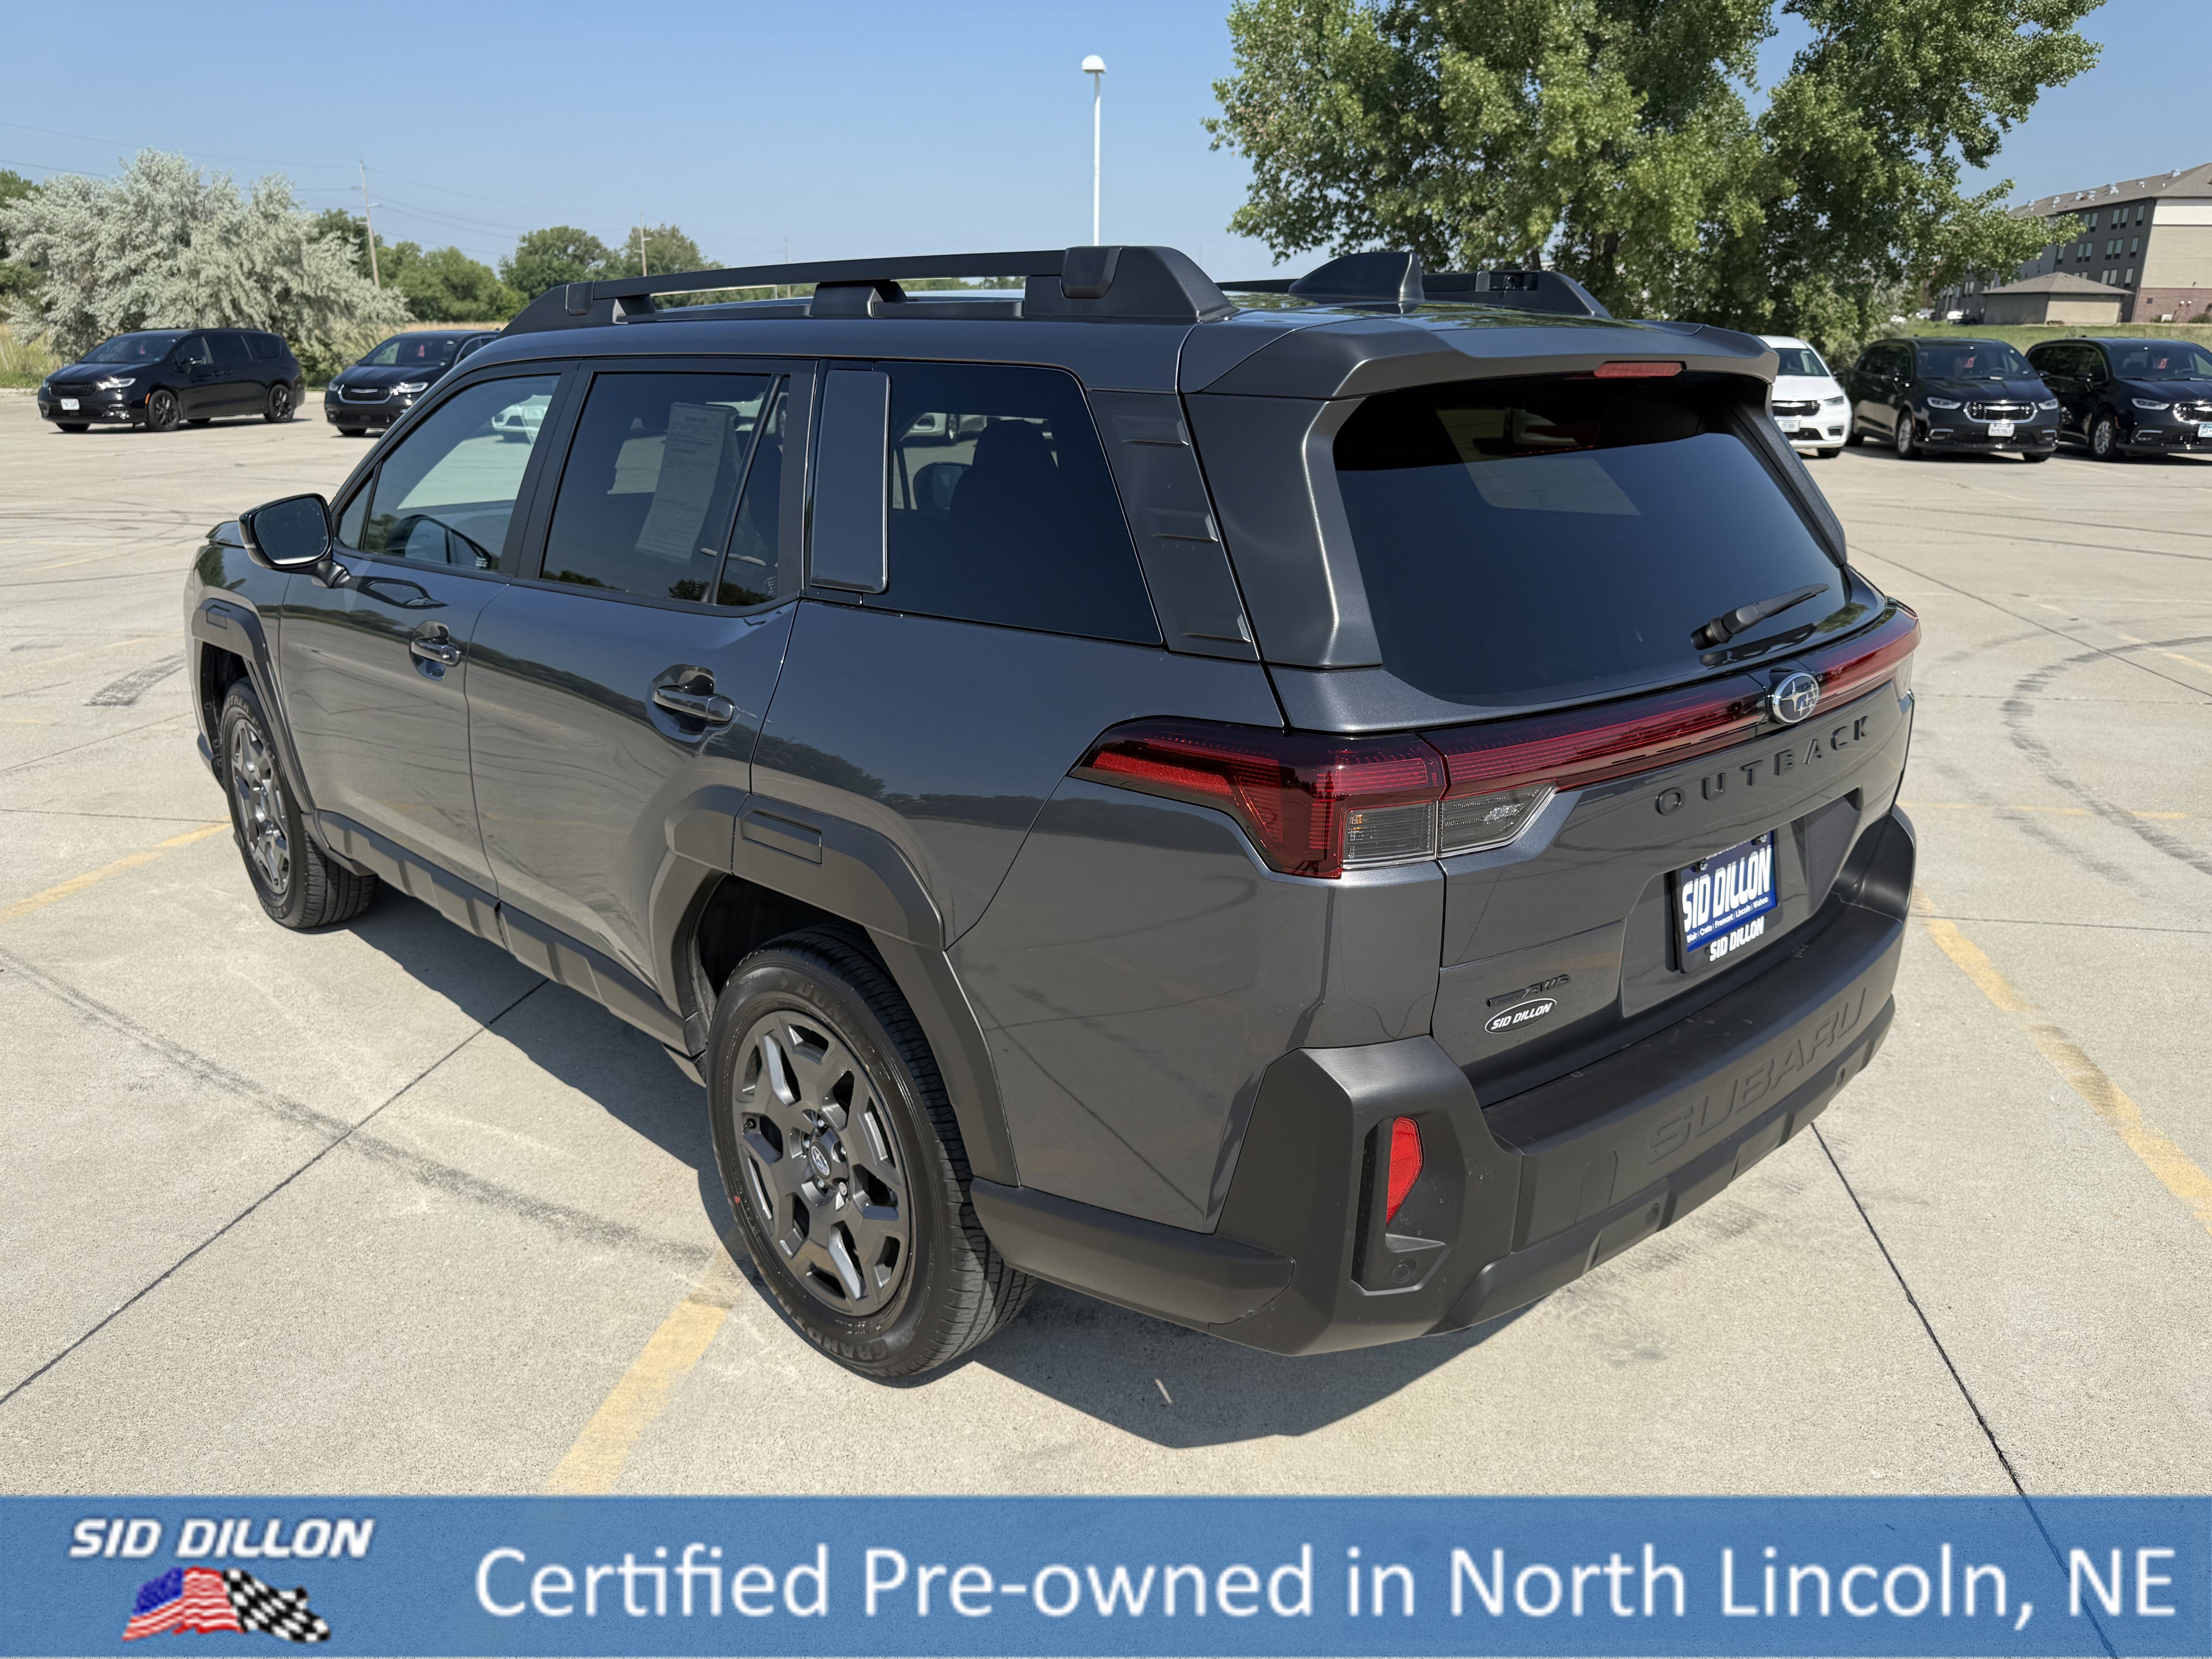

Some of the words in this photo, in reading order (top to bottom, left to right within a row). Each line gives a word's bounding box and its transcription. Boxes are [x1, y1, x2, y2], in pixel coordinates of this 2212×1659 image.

[1655, 715, 1869, 816] OUTBACK
[1682, 874, 1711, 932] SID
[1712, 845, 1772, 918] DILLON
[1686, 932, 1697, 943] Blair
[1699, 925, 1713, 936] Crete
[1714, 913, 1734, 929] Fremont
[1735, 905, 1751, 918] Lincoln
[1753, 896, 1769, 908] Wahoo
[1709, 936, 1728, 962] SID
[1729, 916, 1765, 951] DILLON
[1491, 1016, 1512, 1030] SID
[1512, 1002, 1553, 1024] DILLON
[1647, 987, 1867, 1156] SUBARU
